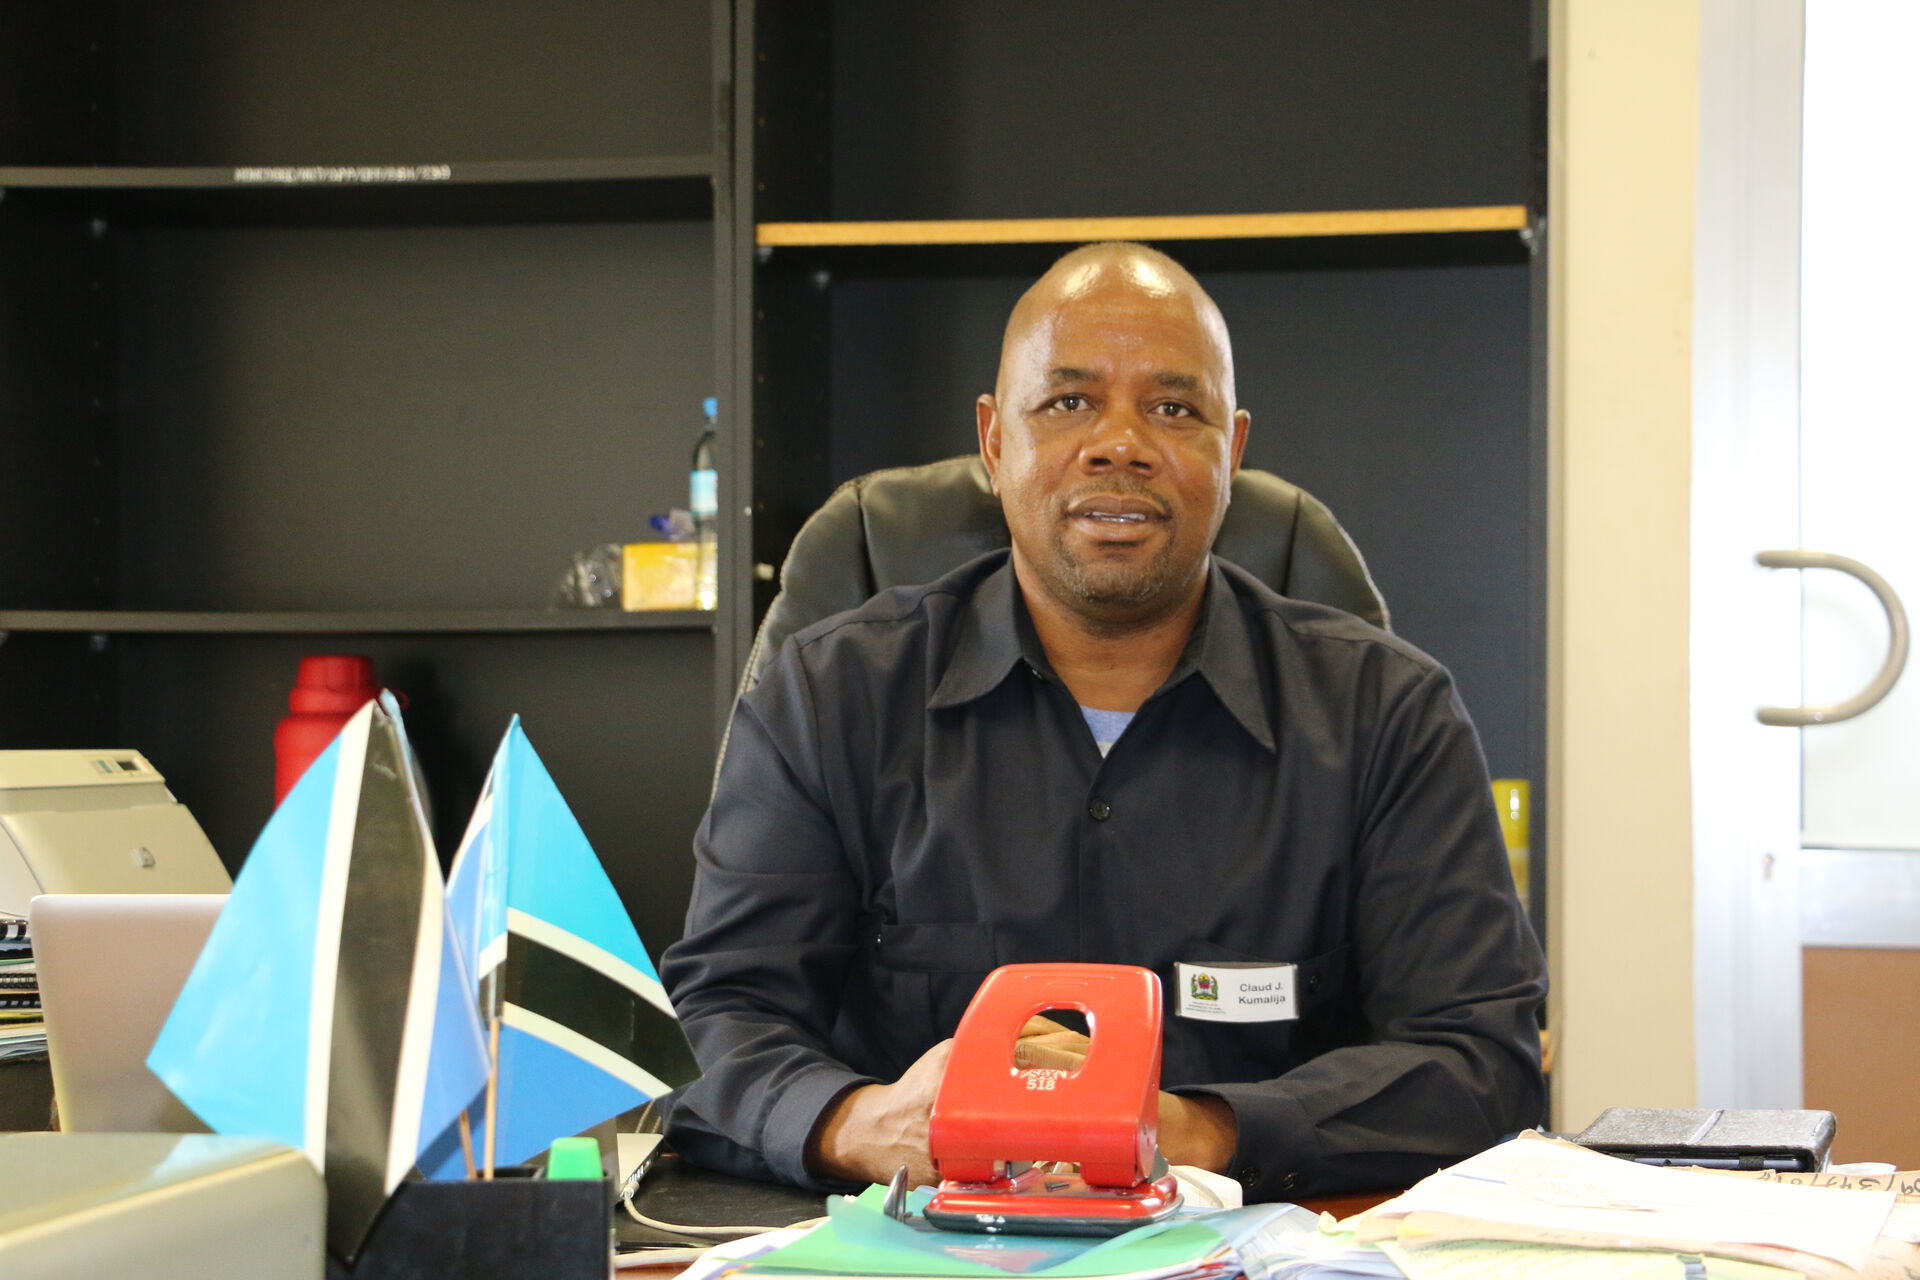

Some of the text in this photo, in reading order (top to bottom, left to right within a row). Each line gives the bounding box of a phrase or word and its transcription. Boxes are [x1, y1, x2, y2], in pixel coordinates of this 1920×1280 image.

[1240, 982, 1283, 992] Claud J.
[1239, 995, 1286, 1005] Kumalija
[1026, 1079, 1056, 1090] 518
